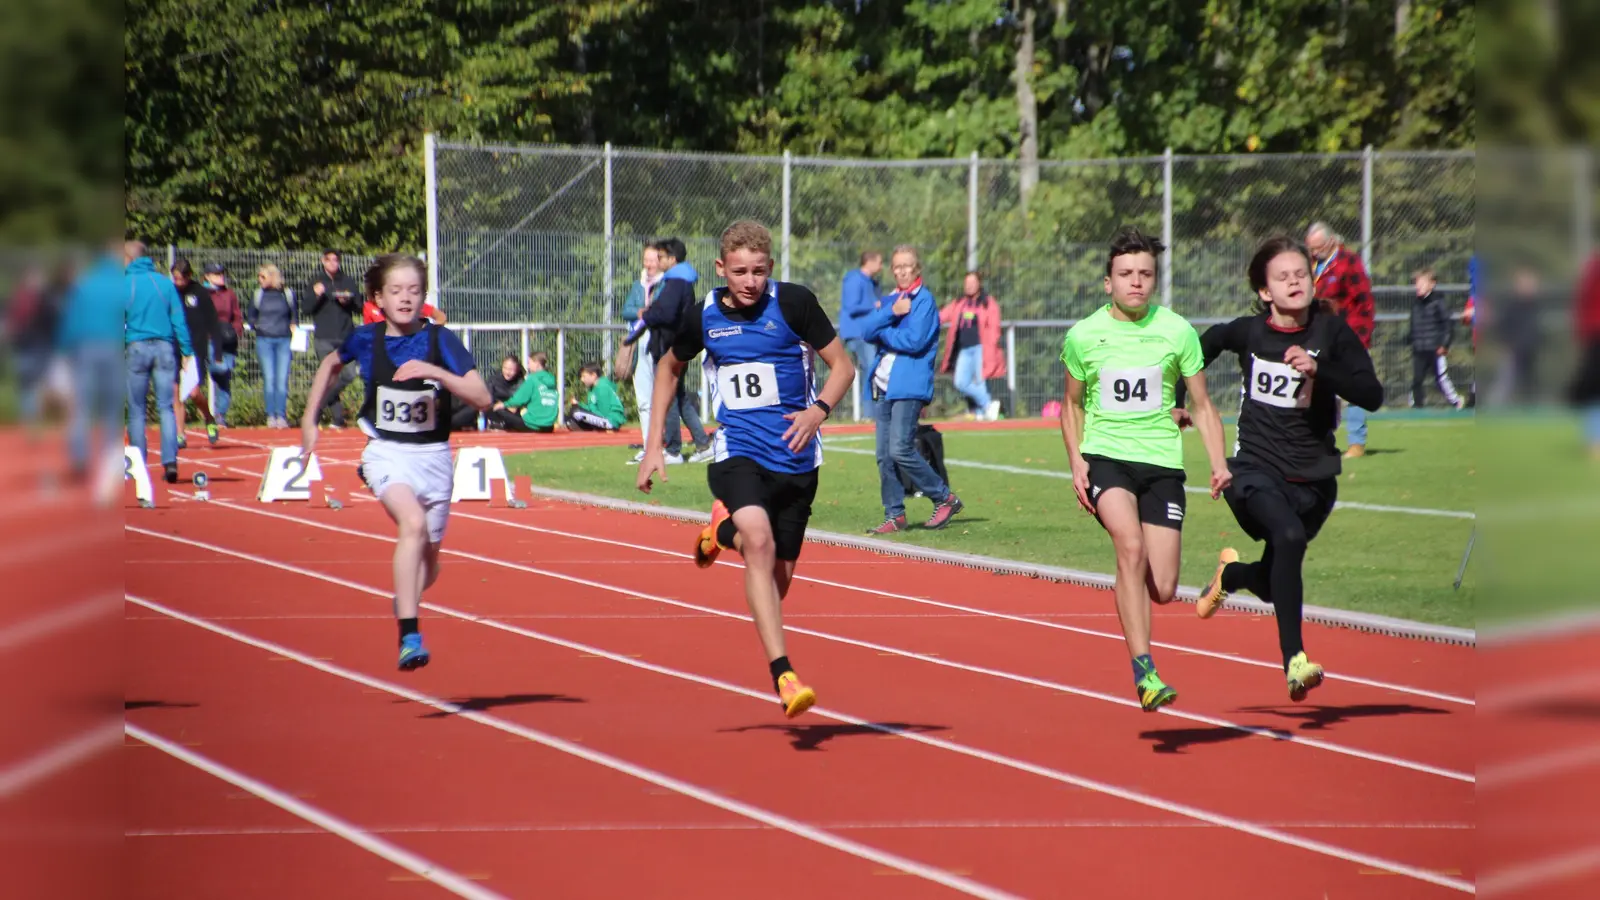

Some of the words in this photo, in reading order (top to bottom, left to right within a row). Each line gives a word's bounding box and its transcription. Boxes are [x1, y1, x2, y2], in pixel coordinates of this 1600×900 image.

[730, 373, 762, 399] 18
[1113, 378, 1148, 402] 94
[1257, 371, 1306, 399] 927
[382, 400, 428, 424] 933
[282, 456, 309, 492] 2
[472, 457, 486, 492] 1
